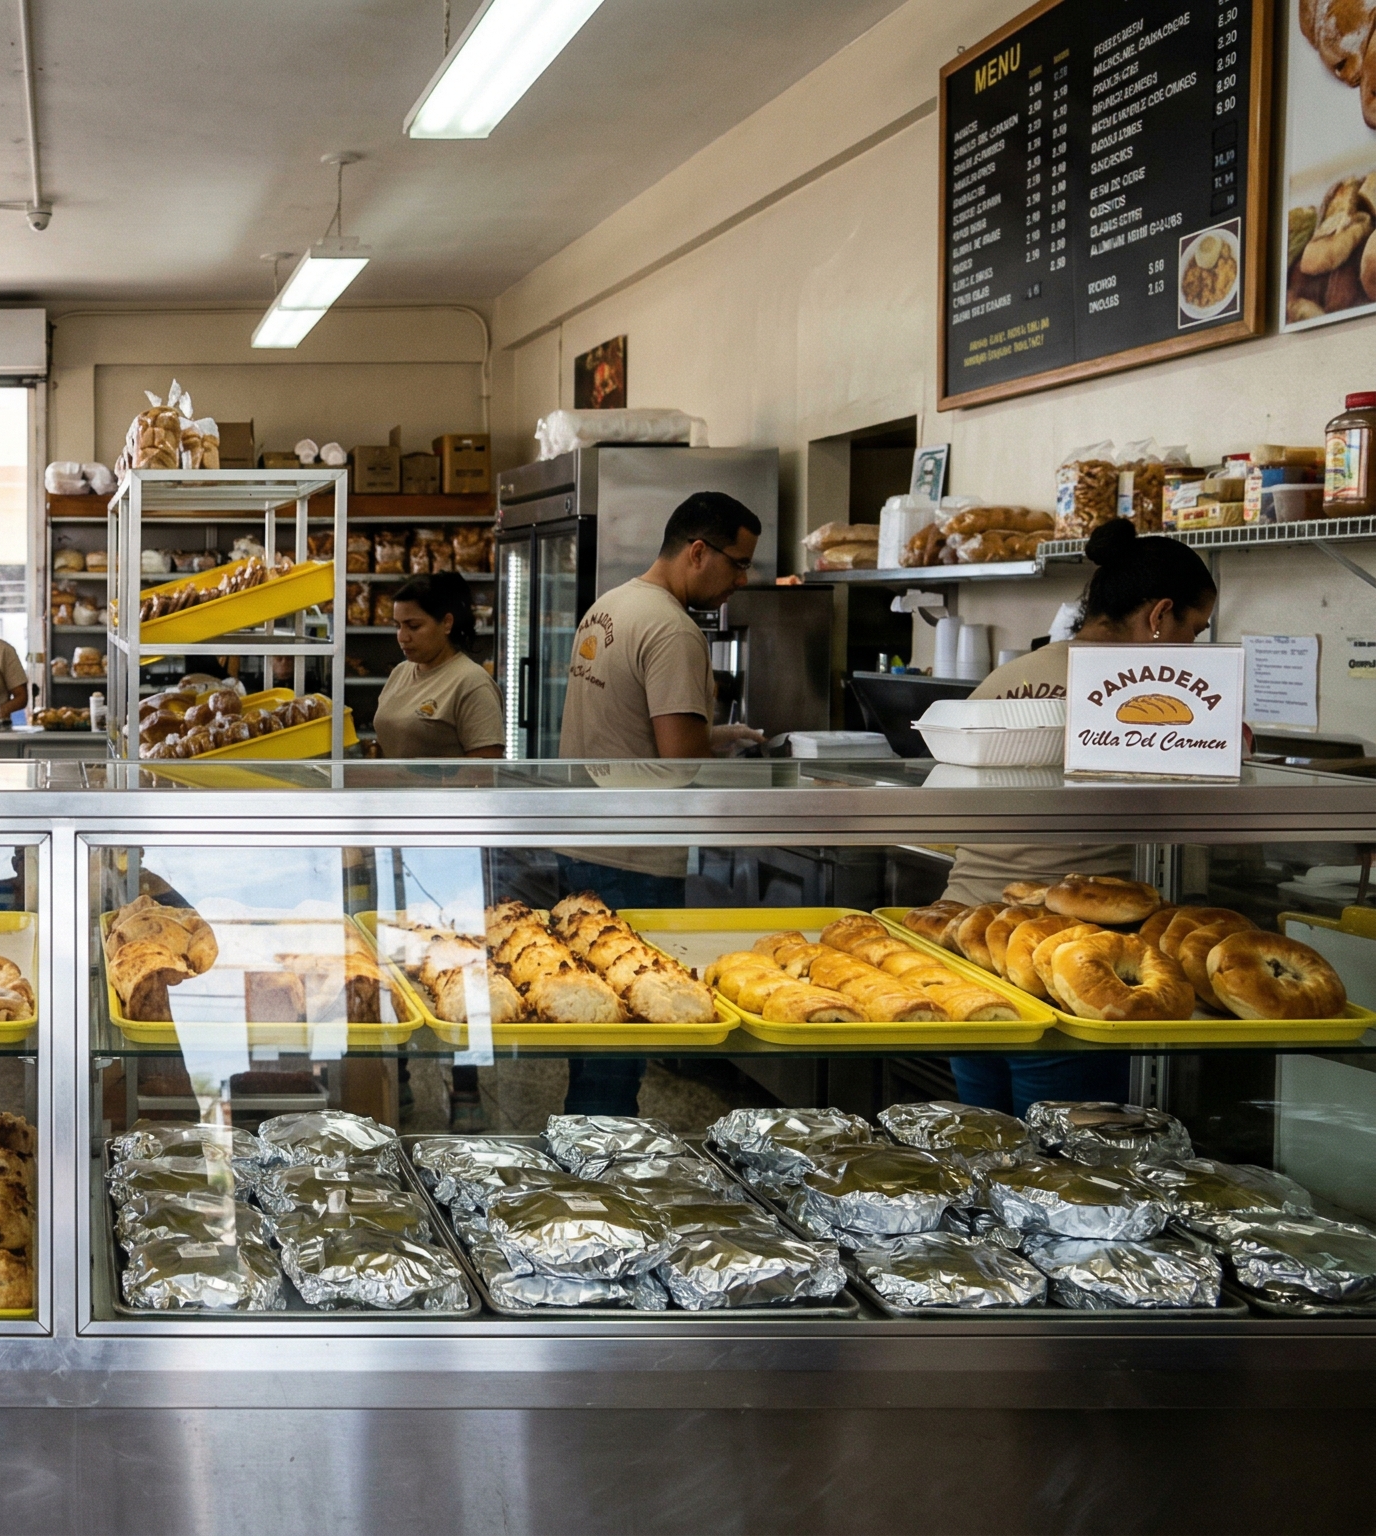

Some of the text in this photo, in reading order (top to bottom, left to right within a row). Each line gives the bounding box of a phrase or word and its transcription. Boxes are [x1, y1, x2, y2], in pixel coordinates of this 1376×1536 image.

[974, 42, 1021, 95] MENU
[1087, 665, 1222, 711] PANADERA
[1078, 729, 1227, 751] Villa Del Carmen
